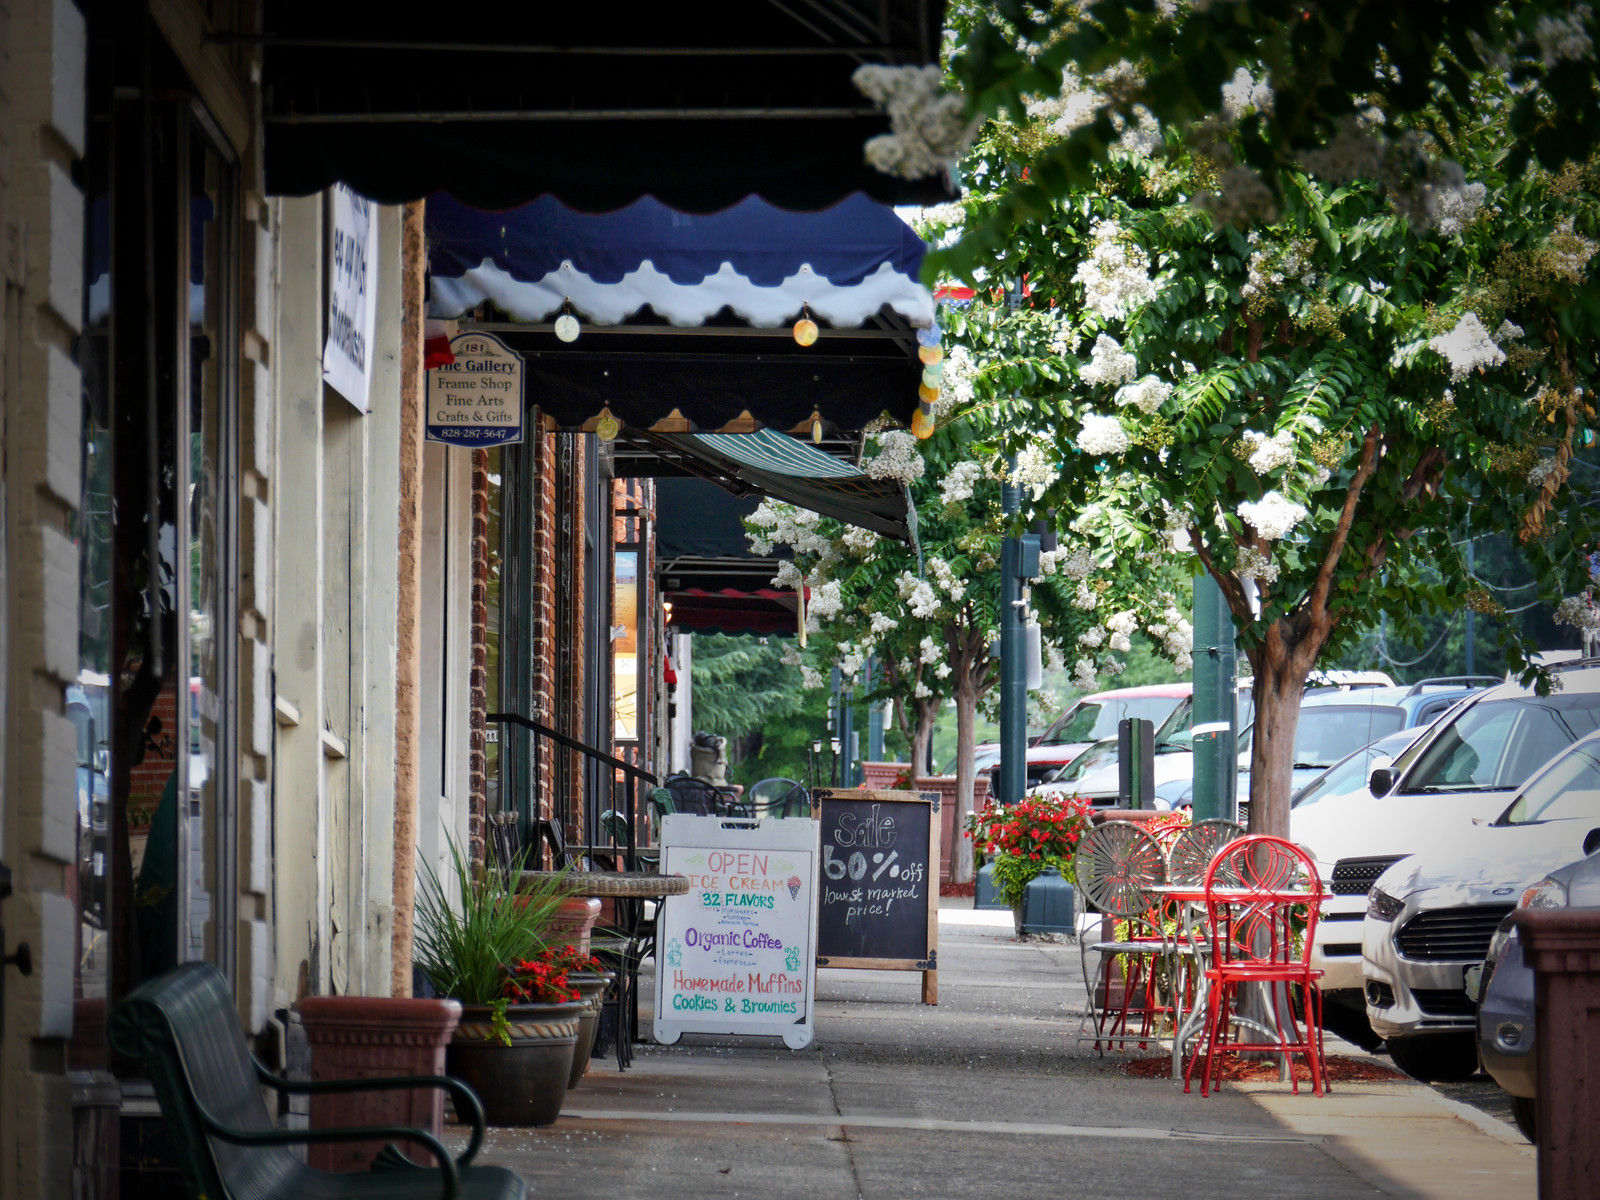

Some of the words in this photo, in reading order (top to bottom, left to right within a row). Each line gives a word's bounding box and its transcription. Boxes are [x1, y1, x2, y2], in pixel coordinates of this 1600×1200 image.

[466, 344, 484, 353] 181
[466, 360, 515, 375] Gallery
[438, 378, 476, 389] Frame
[481, 378, 512, 391] Shop
[446, 394, 473, 406] Fine
[477, 395, 504, 406] Arts
[437, 411, 469, 422] Crafts
[473, 411, 483, 422] &
[486, 411, 513, 422] Gifts
[441, 428, 506, 439] 828-287-5647
[834, 803, 897, 848] Sale
[708, 852, 768, 875] OPEN
[823, 844, 899, 882] 60%
[900, 862, 924, 882] off
[688, 874, 720, 889] ICE
[729, 876, 784, 891] CREAM
[702, 892, 721, 907] 32
[725, 893, 775, 909] FLAVORS
[867, 884, 919, 901] marked
[845, 899, 893, 925] price!
[685, 928, 741, 951] Organic
[743, 929, 783, 949] Coffee
[673, 970, 745, 993] Homemade
[748, 972, 802, 993] Muffins
[673, 993, 718, 1011] Cookies
[724, 997, 736, 1013] &
[741, 998, 797, 1014] Brownies
